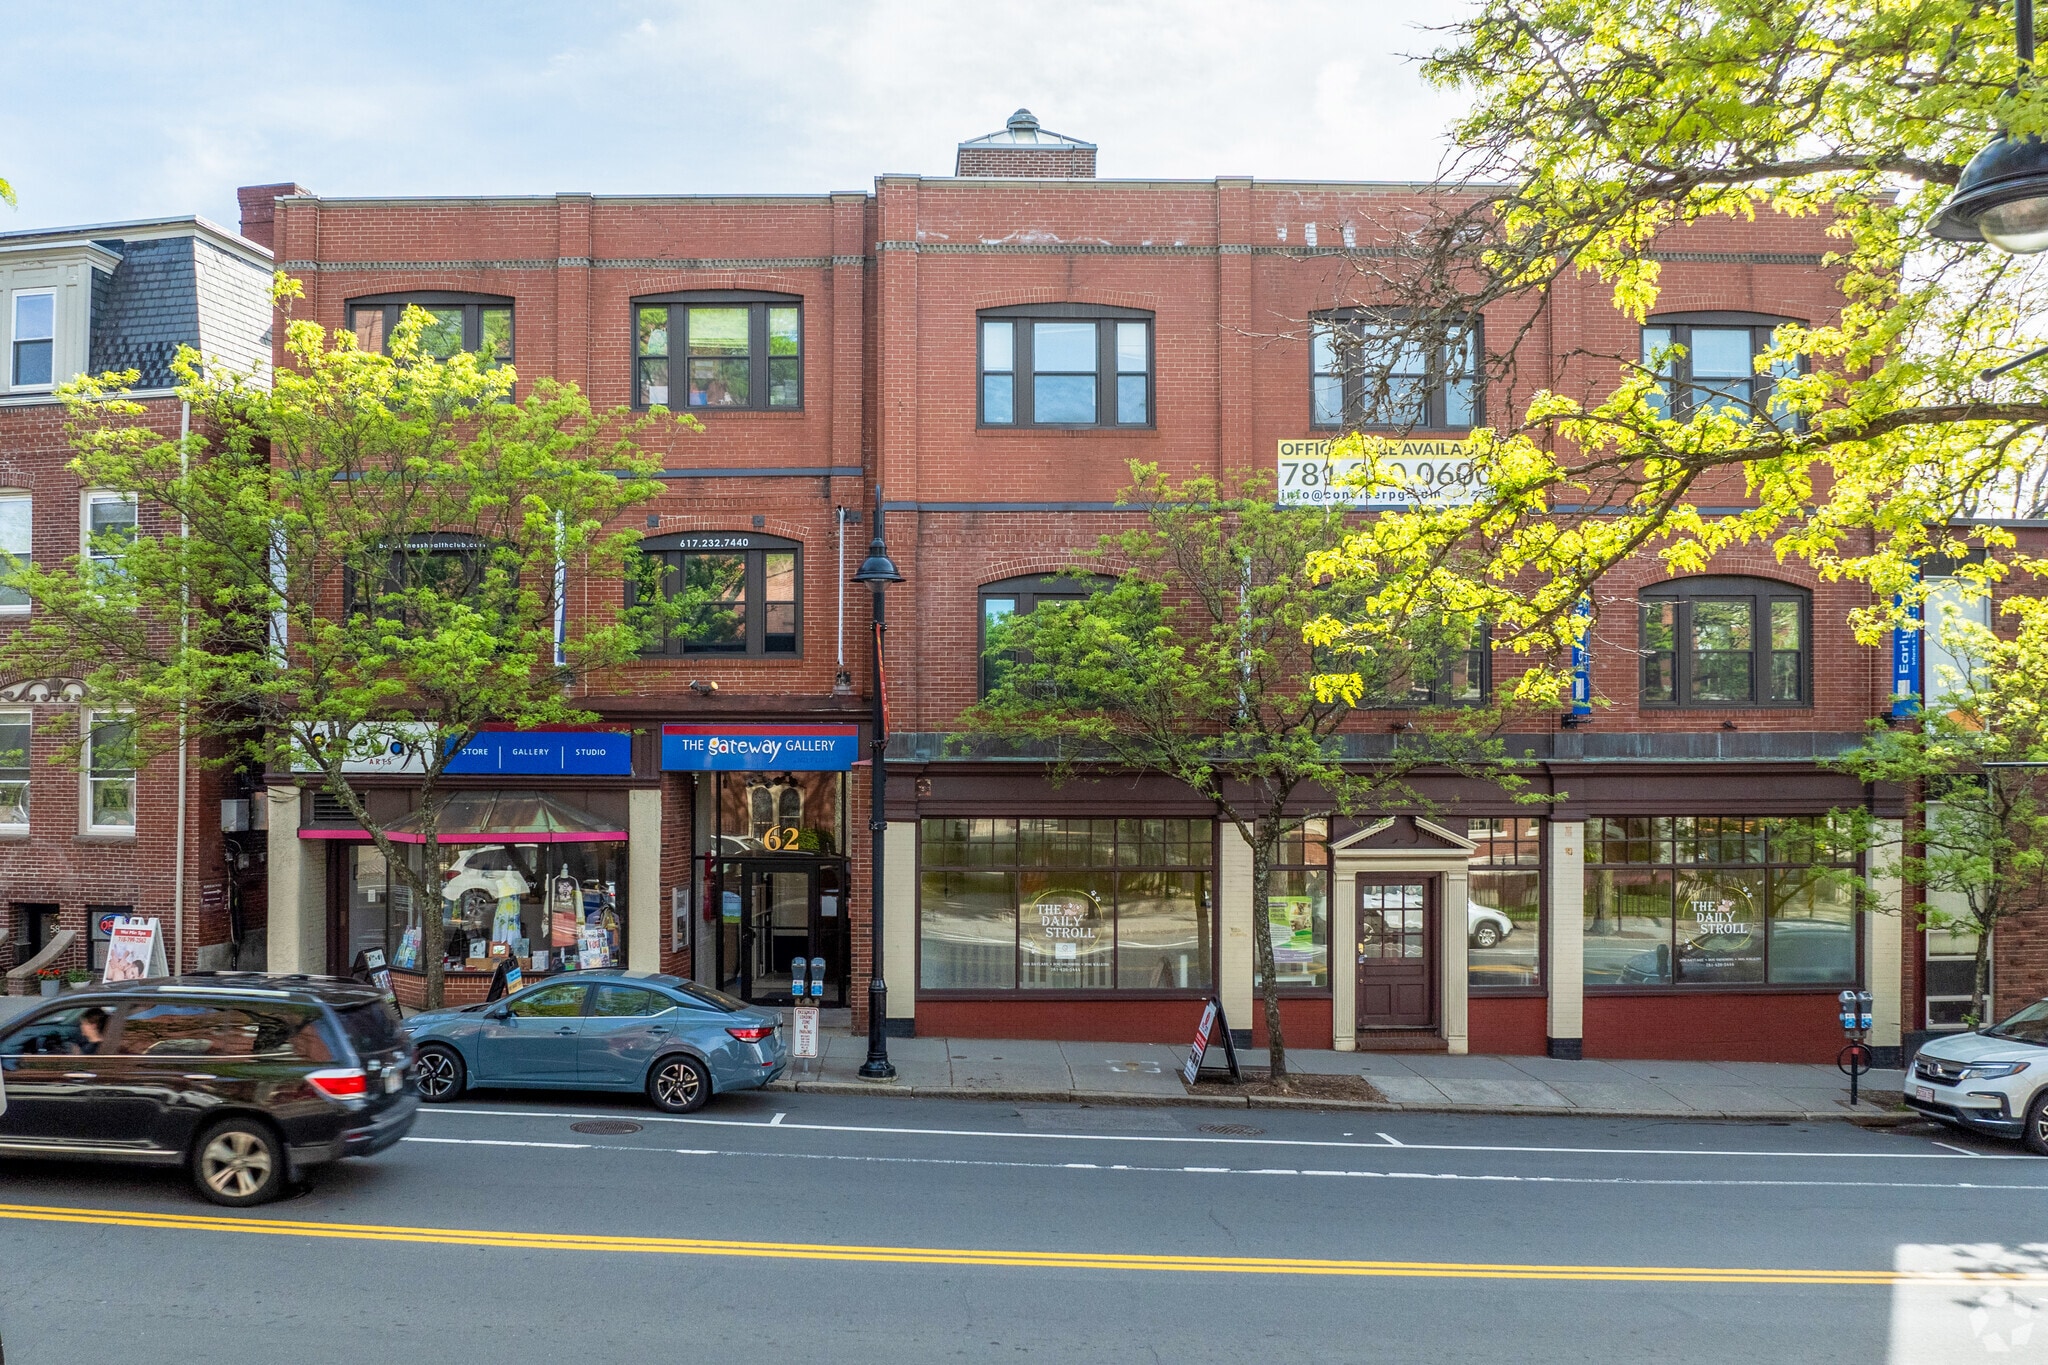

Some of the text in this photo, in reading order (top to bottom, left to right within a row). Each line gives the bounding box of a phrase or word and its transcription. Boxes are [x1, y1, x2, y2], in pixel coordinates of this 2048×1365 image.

[679, 538, 749, 548] 617.232.7440
[462, 748, 489, 756] STORE
[512, 748, 550, 756] GALLERY
[575, 748, 607, 756] STUDIO
[682, 739, 704, 751] THE
[708, 737, 782, 763] gateway
[785, 740, 836, 752] GALLERY
[763, 825, 799, 851] 62
[1036, 904, 1062, 915] THE
[1690, 901, 1716, 912] THE
[1041, 915, 1084, 927] DAILY
[1696, 911, 1736, 923] DAILY
[1045, 927, 1096, 938] STROLL
[1700, 923, 1748, 935] STROLL
